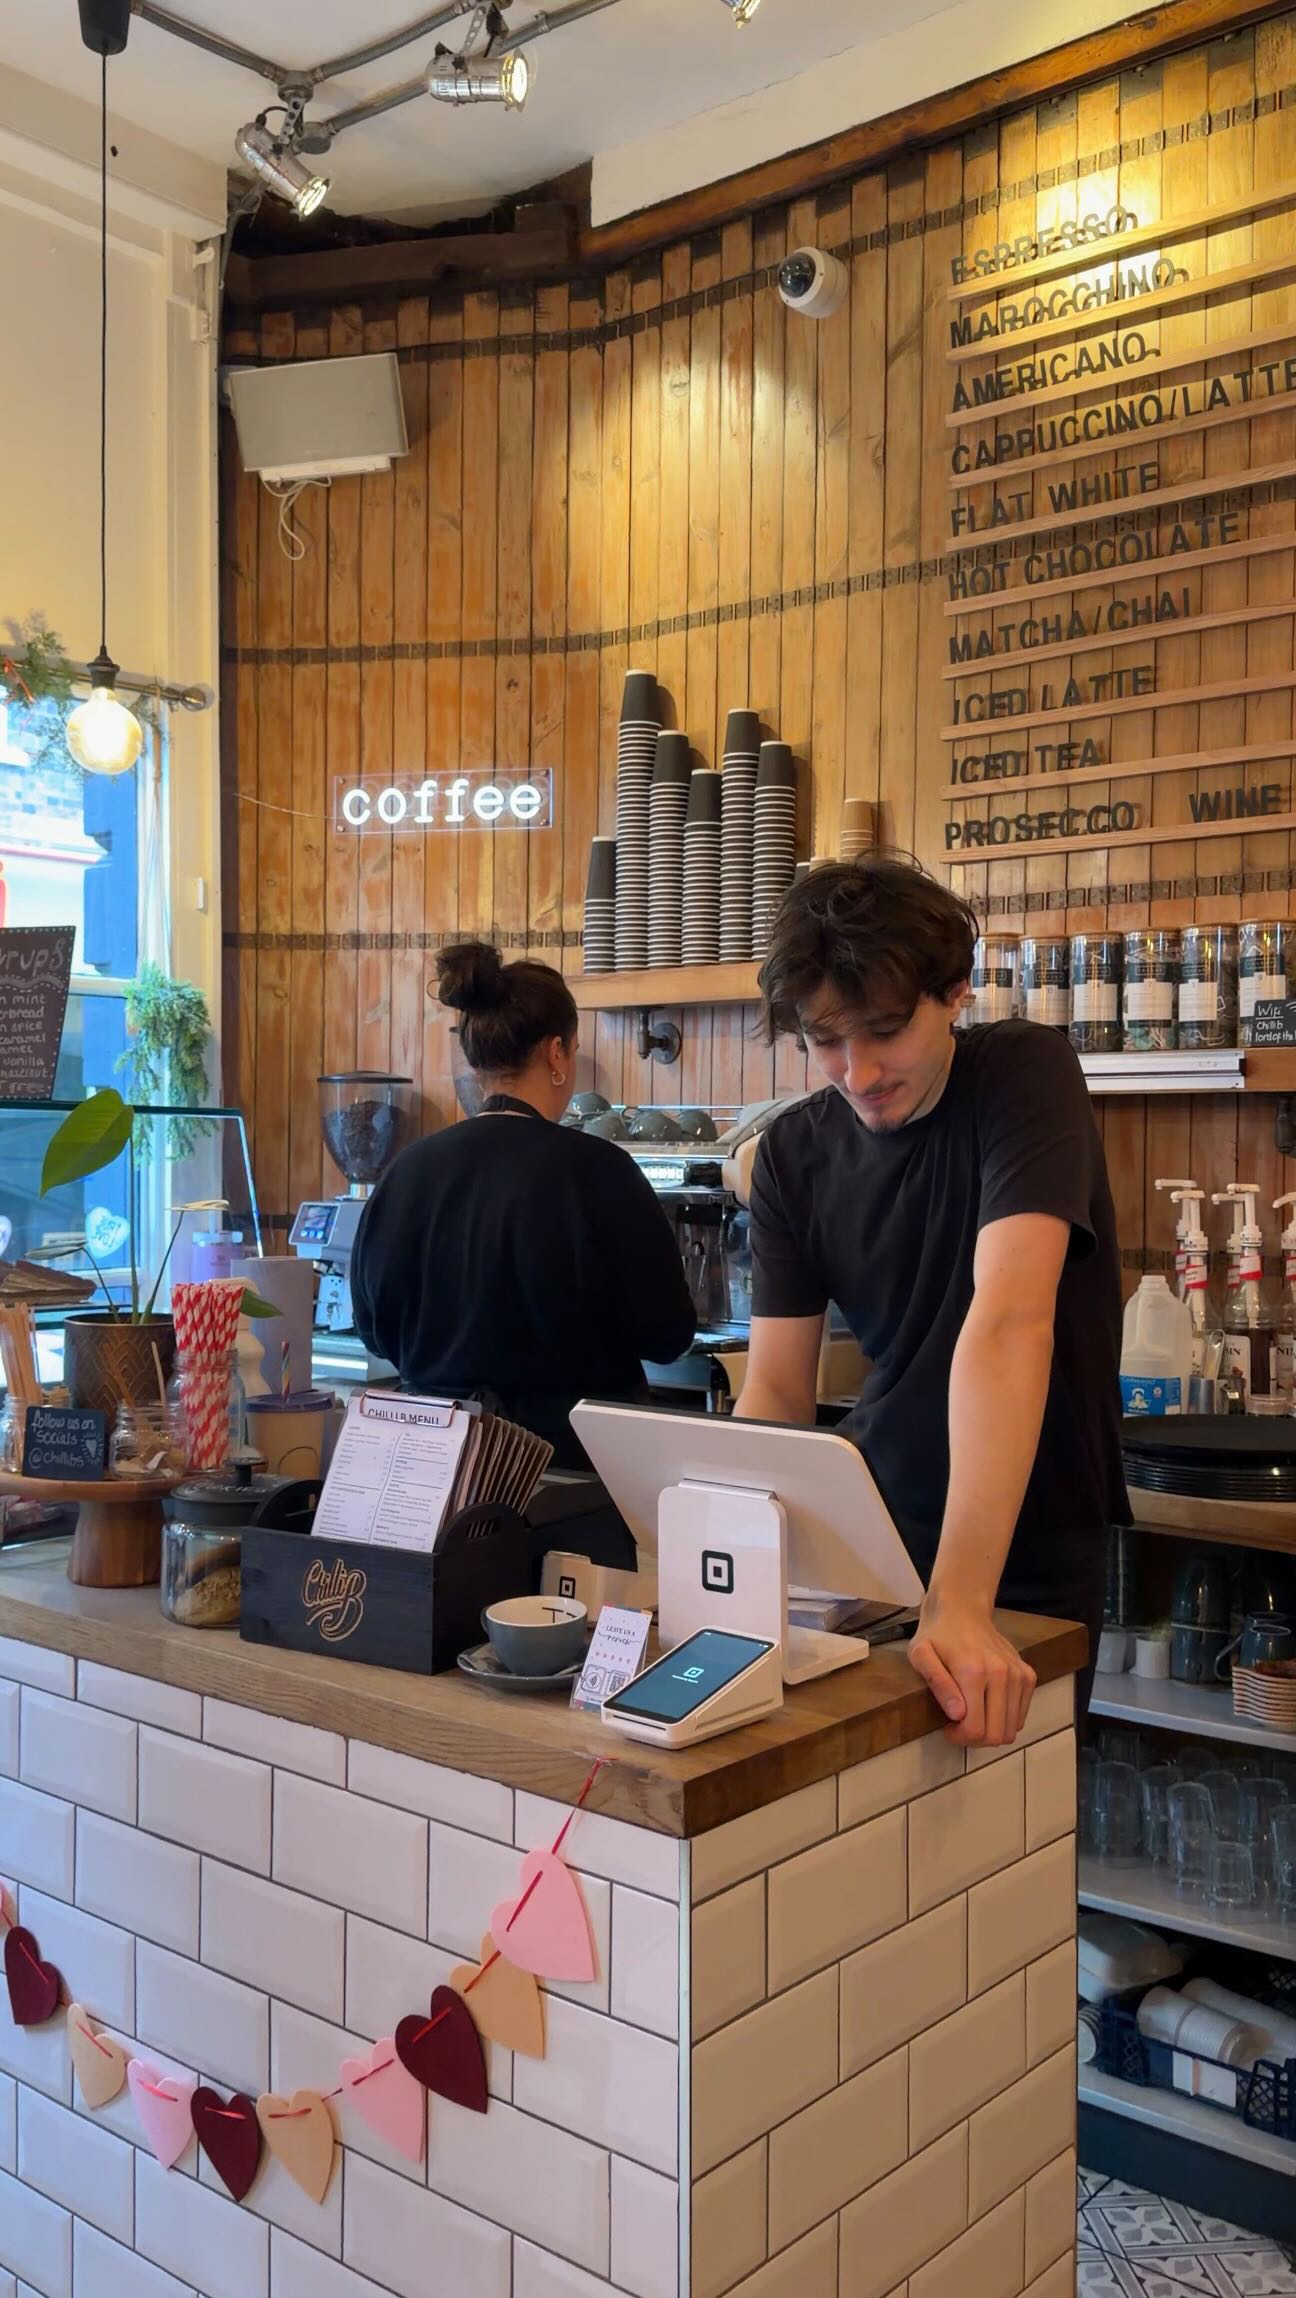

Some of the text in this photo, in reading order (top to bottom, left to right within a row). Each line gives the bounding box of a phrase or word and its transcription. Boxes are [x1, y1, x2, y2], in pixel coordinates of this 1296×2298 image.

[951, 204, 1128, 286] ESPRESSO
[950, 257, 1176, 349] MAROCCHINO
[952, 331, 1147, 413] AMERICANO
[951, 461, 1159, 537] FLAT WHITE
[949, 511, 1241, 601] HOT CHOCOLATE
[949, 587, 1191, 664] MATCHA/CHAI
[953, 664, 1154, 726] ICED LATTE
[951, 738, 1101, 785] ICED TEA
[342, 778, 542, 826] coffee
[944, 783, 1282, 850] PROSECCO WINE
